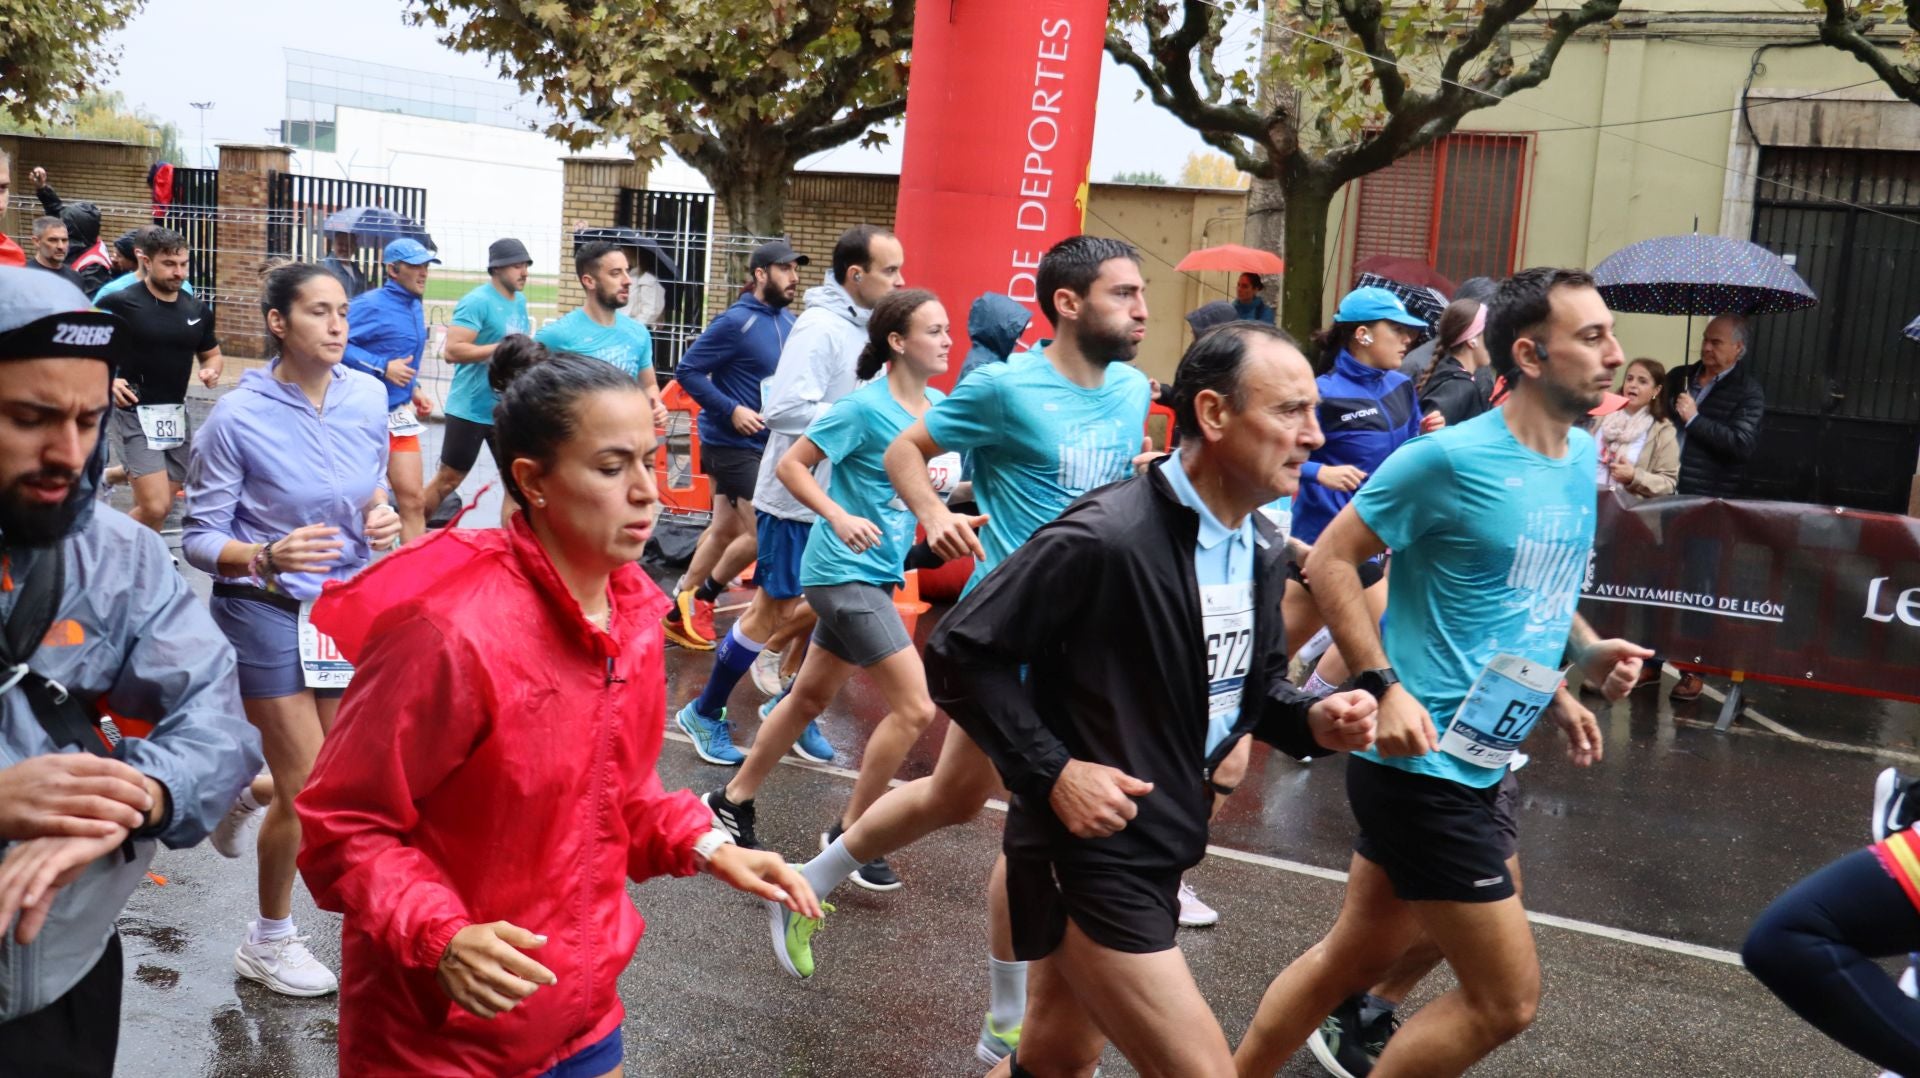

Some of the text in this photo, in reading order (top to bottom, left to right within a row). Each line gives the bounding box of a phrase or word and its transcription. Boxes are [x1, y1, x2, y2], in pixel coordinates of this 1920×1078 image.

[1017, 18, 1072, 231] DEPORTES
[1008, 250, 1043, 303] DE
[52, 323, 115, 345] 226ERS
[156, 420, 177, 437] 831
[1341, 408, 1378, 421] GIVOVA
[1595, 583, 1785, 617] AYUNTAMIENTO DE LEÓN
[1862, 576, 1920, 627] Le
